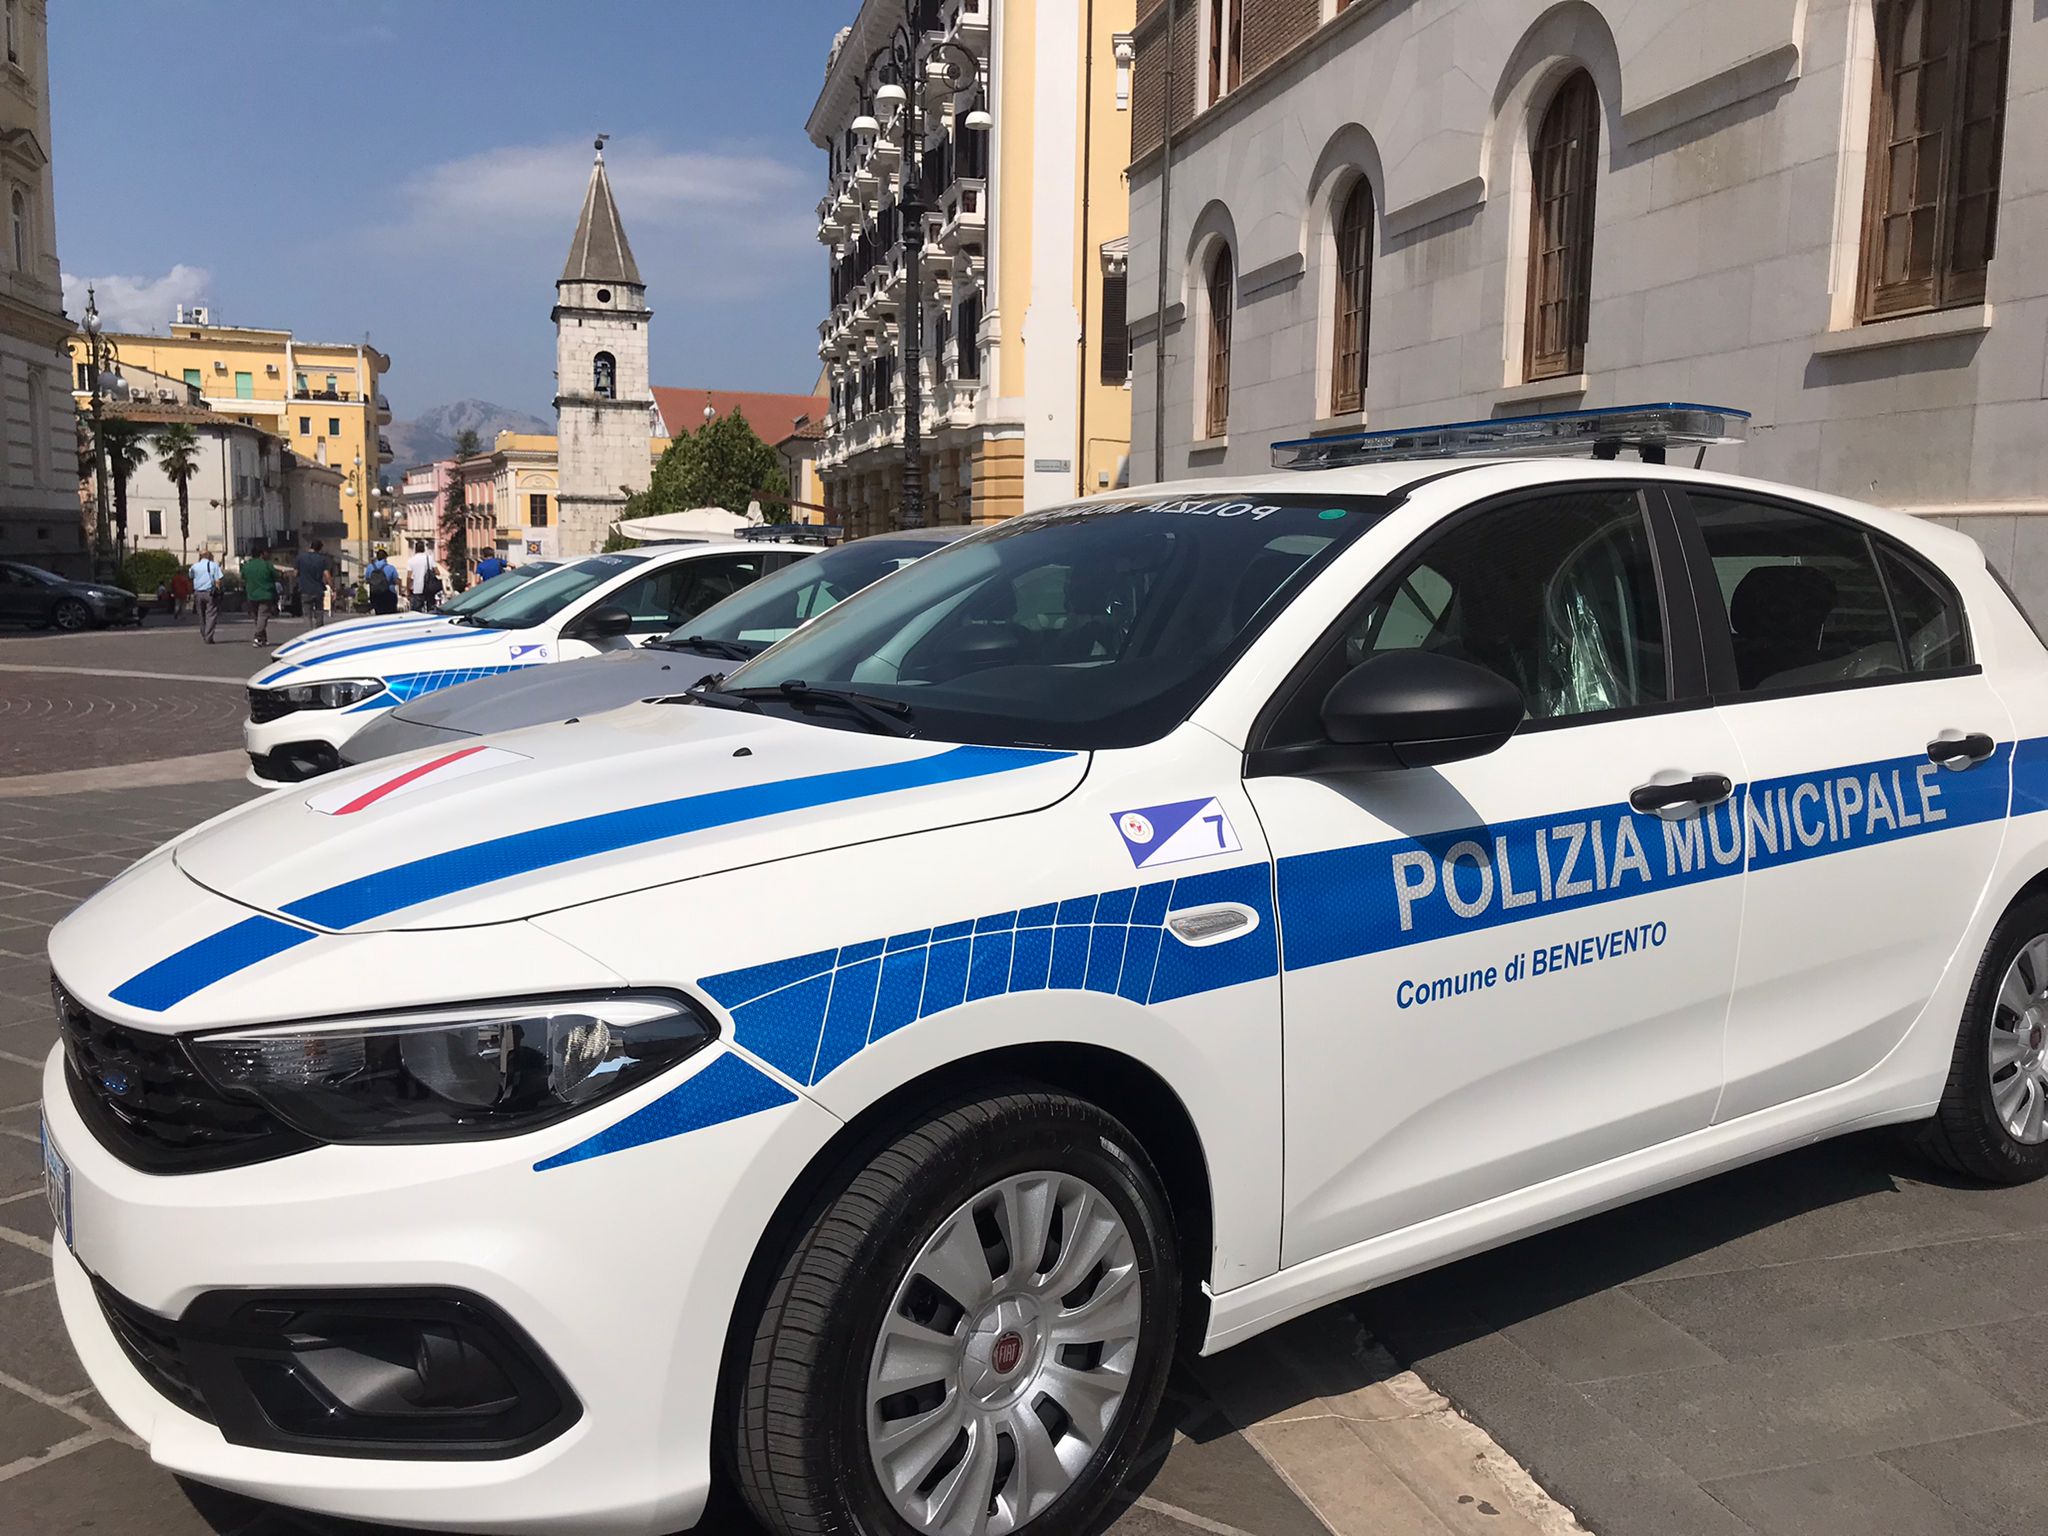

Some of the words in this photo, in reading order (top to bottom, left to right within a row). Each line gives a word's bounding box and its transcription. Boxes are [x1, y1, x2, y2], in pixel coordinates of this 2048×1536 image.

[540, 648, 548, 658] 6
[1203, 814, 1226, 848] 7
[1392, 815, 1652, 931] POLIZIA
[1662, 763, 1947, 877] MUNICIPALE
[1396, 966, 1497, 1009] Comune
[1505, 953, 1525, 982] di
[1532, 921, 1667, 976] BENEVENTO
[999, 1343, 1017, 1363] FIAT
